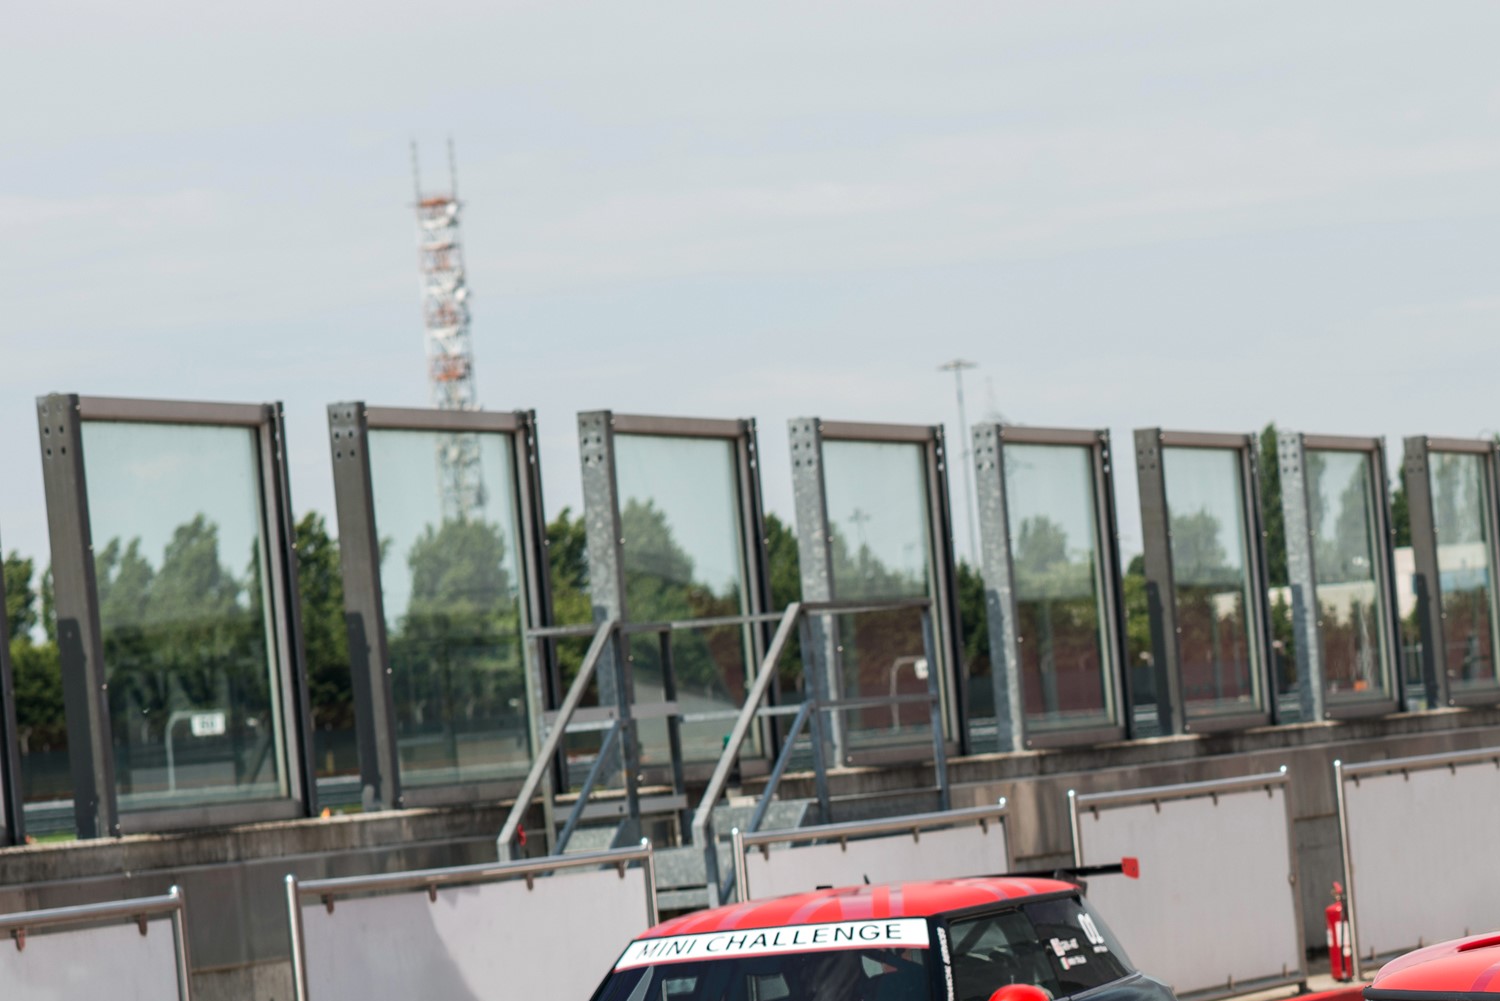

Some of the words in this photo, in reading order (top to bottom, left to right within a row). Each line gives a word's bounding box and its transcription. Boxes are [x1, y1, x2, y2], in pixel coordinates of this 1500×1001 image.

[636, 938, 698, 960] MINI
[706, 923, 902, 953] CHALLENGE
[1078, 913, 1104, 944] 01
